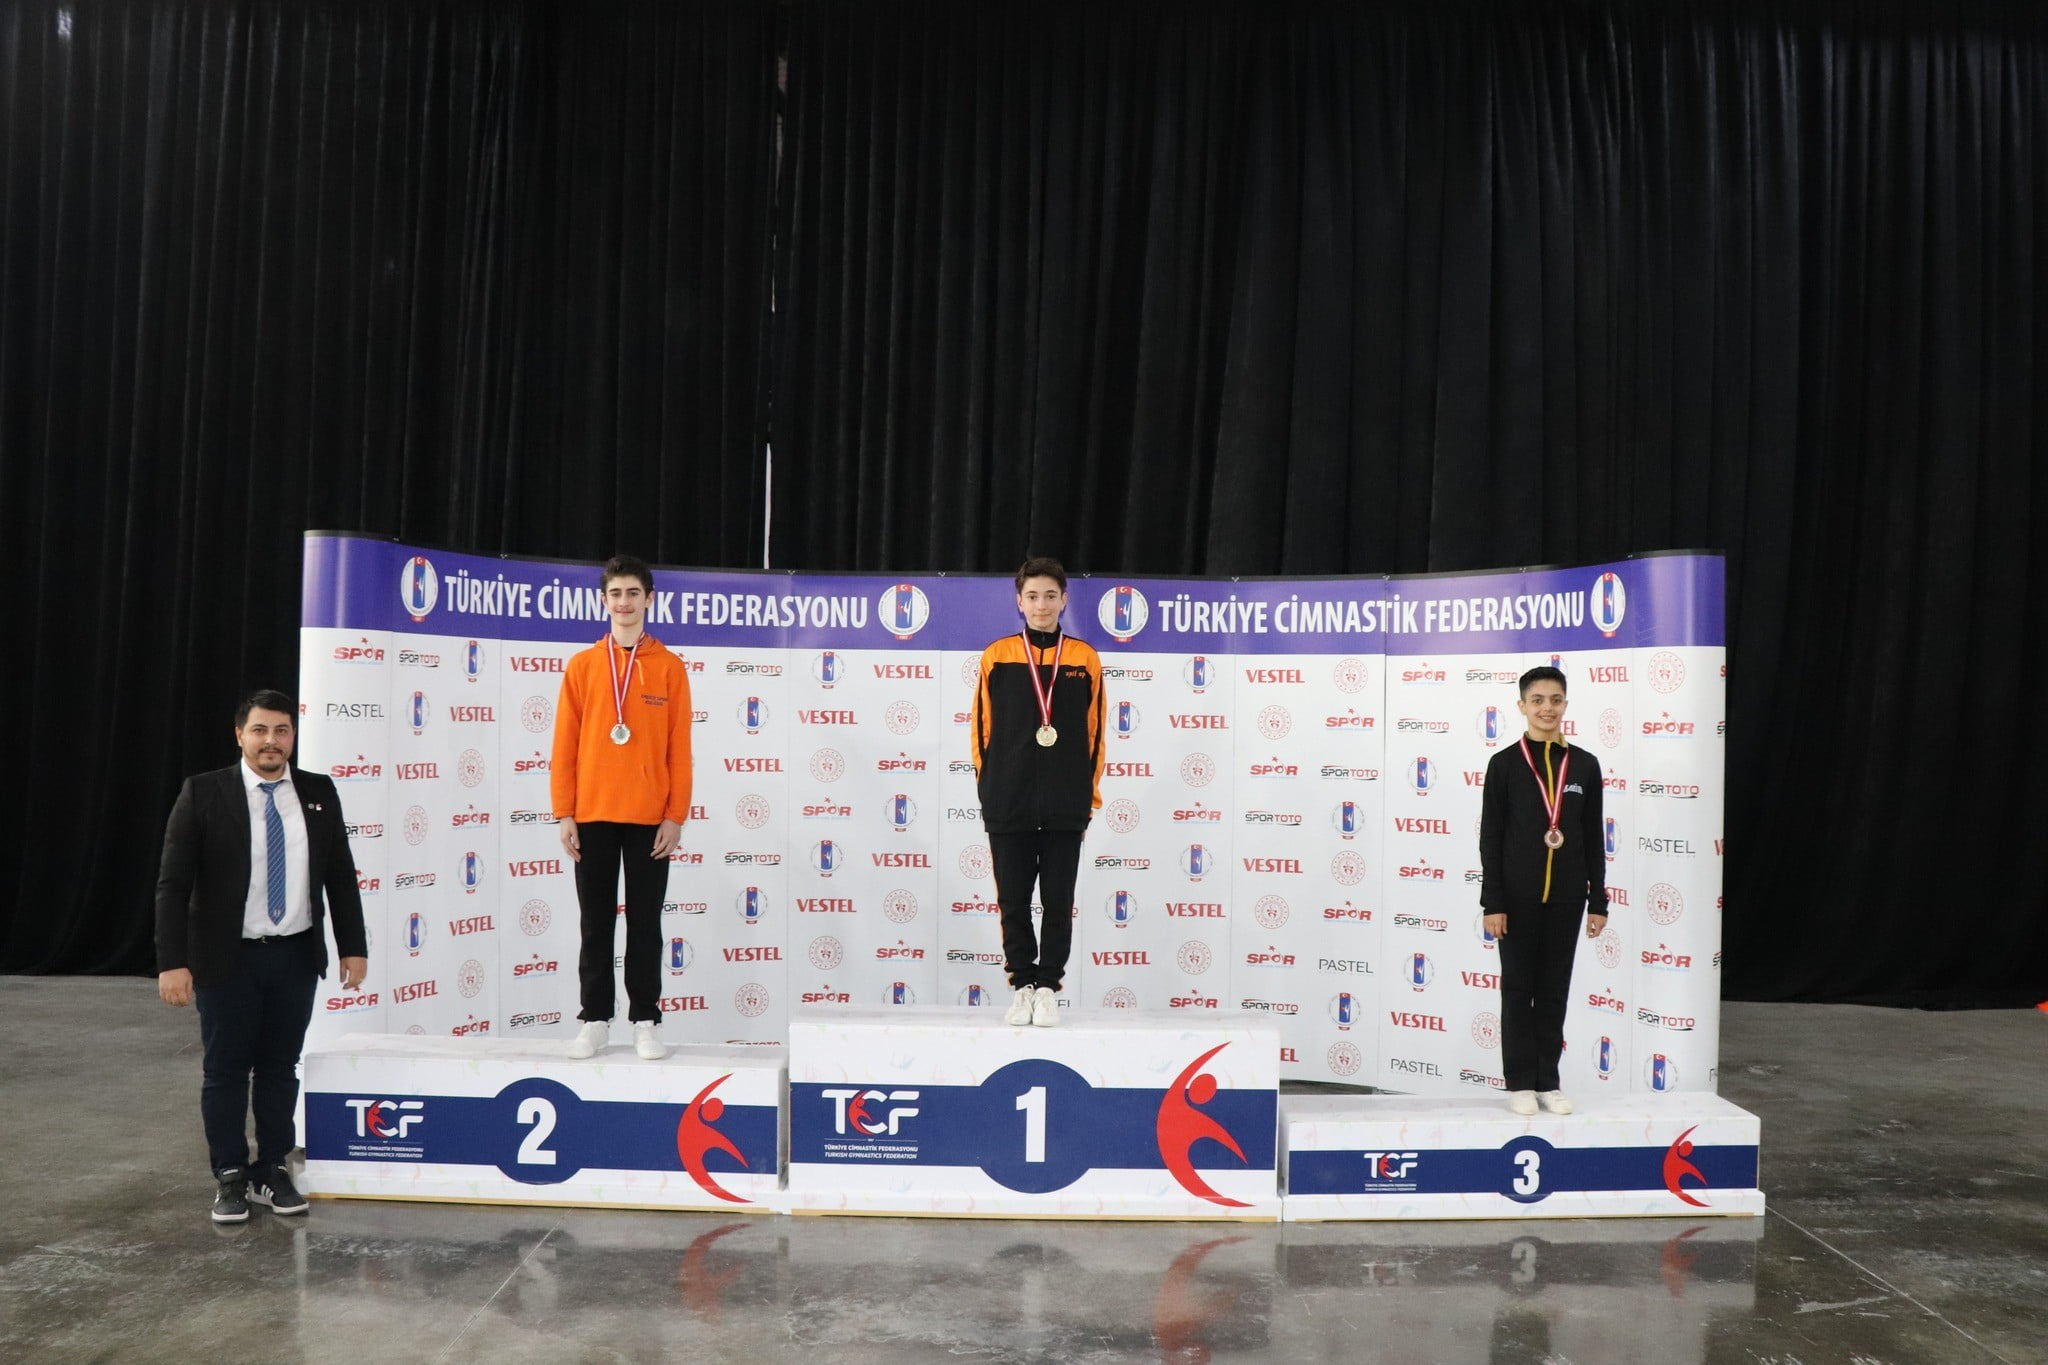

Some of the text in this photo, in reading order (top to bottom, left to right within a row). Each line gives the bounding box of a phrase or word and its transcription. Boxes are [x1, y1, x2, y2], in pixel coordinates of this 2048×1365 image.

[445, 569, 531, 618] TÜRKİYE
[538, 578, 674, 624] CİMNİK
[681, 592, 867, 629] FEDERASYONU
[1158, 594, 1267, 634] TÜRKİYE
[1274, 594, 1418, 634] CİMNASTİK
[1424, 591, 1584, 633] FEDERASYONU
[334, 647, 384, 660] SPOR
[511, 657, 564, 672] VESTEL
[874, 665, 933, 679] VESTEL
[1246, 669, 1305, 683] VESTEL
[1402, 671, 1446, 682] SPOR
[1589, 666, 1629, 683] VESTEL
[327, 704, 384, 717] PASTEL
[450, 707, 495, 721] VESTEL
[798, 710, 858, 724] VESTEL
[1169, 715, 1229, 729] VESTEL
[1326, 717, 1374, 727] SPOR
[1642, 722, 1694, 734] SPOR
[331, 765, 381, 777] SPOR
[397, 763, 439, 780] VESTEL
[514, 761, 551, 771] SPO
[724, 758, 783, 772] VESTEL
[878, 760, 926, 771] SPOR
[1250, 765, 1298, 775] SPOR
[803, 806, 851, 816] SPOR
[1173, 810, 1221, 820] SPOR
[452, 813, 489, 826] SPOR
[1395, 818, 1450, 834] VESTEL
[1639, 837, 1696, 853] PASTEL
[872, 853, 931, 868] VESTEL
[1244, 858, 1303, 873] VESTEL
[509, 860, 563, 877] VESTEL
[1399, 866, 1444, 879] SPOR
[797, 899, 856, 912] VESTEL
[951, 902, 999, 913] SPOR
[1166, 903, 1226, 917] VESTEL
[1323, 908, 1372, 920] SPOR
[450, 916, 495, 936] VESTEL
[723, 947, 782, 961] VESTEL
[876, 948, 924, 958] SPOR
[1092, 952, 1151, 965] VESTEL
[1247, 953, 1295, 965] SPOR
[1641, 951, 1691, 968] SPOR
[513, 961, 558, 976] SPOR
[1319, 958, 1373, 973] PASTEL
[394, 980, 438, 1003] VESTEL
[801, 992, 850, 1003] SPOR
[326, 994, 379, 1010] SPOR
[1169, 997, 1217, 1008] SPOR
[1589, 994, 1624, 1012] SPOR
[1390, 1012, 1446, 1032] VESTEL
[1390, 1058, 1442, 1077] PASTEL
[345, 1099, 424, 1138] TCF
[822, 1089, 919, 1135] TCF
[516, 1096, 557, 1165] 2
[1015, 1086, 1047, 1163] 1
[1364, 1152, 1418, 1178] TCF
[1513, 1150, 1540, 1195] 3
